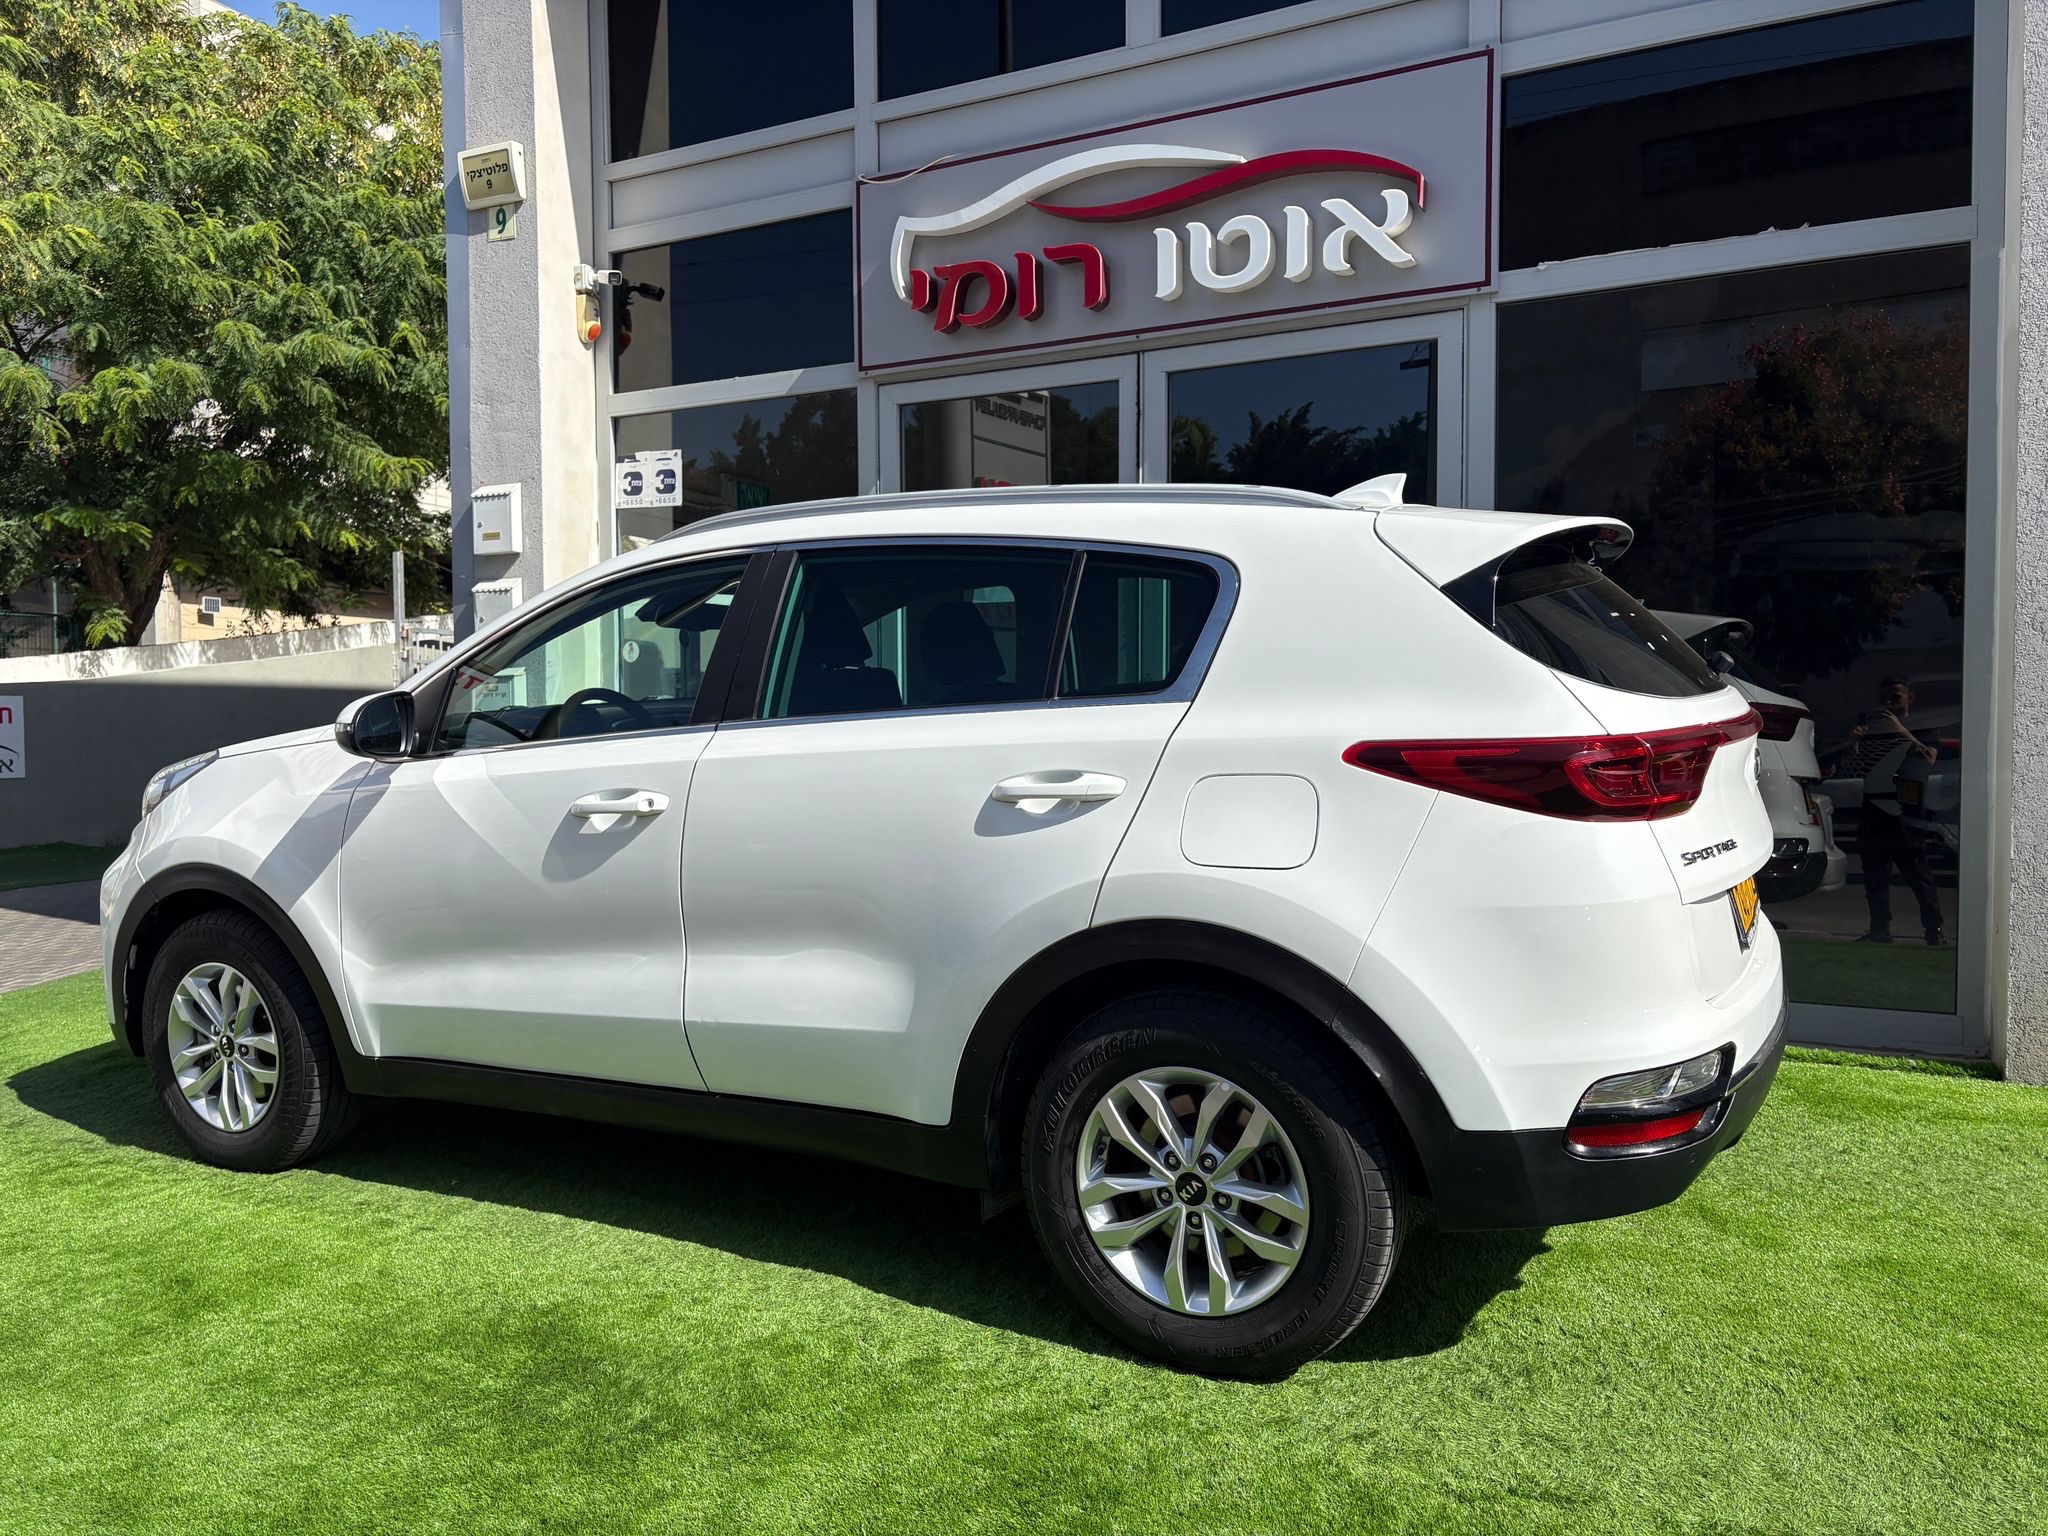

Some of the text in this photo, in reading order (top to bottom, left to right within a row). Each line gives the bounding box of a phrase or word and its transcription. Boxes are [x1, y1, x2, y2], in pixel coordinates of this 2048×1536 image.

[466, 162, 508, 182] פלוטיצקי
[486, 179, 493, 189] 9
[496, 208, 507, 234] 9
[911, 188, 1417, 335] אוטו רומי
[1681, 839, 1738, 867] SPORTAGE
[222, 1036, 231, 1057] KIA
[1179, 1180, 1203, 1201] KIA
